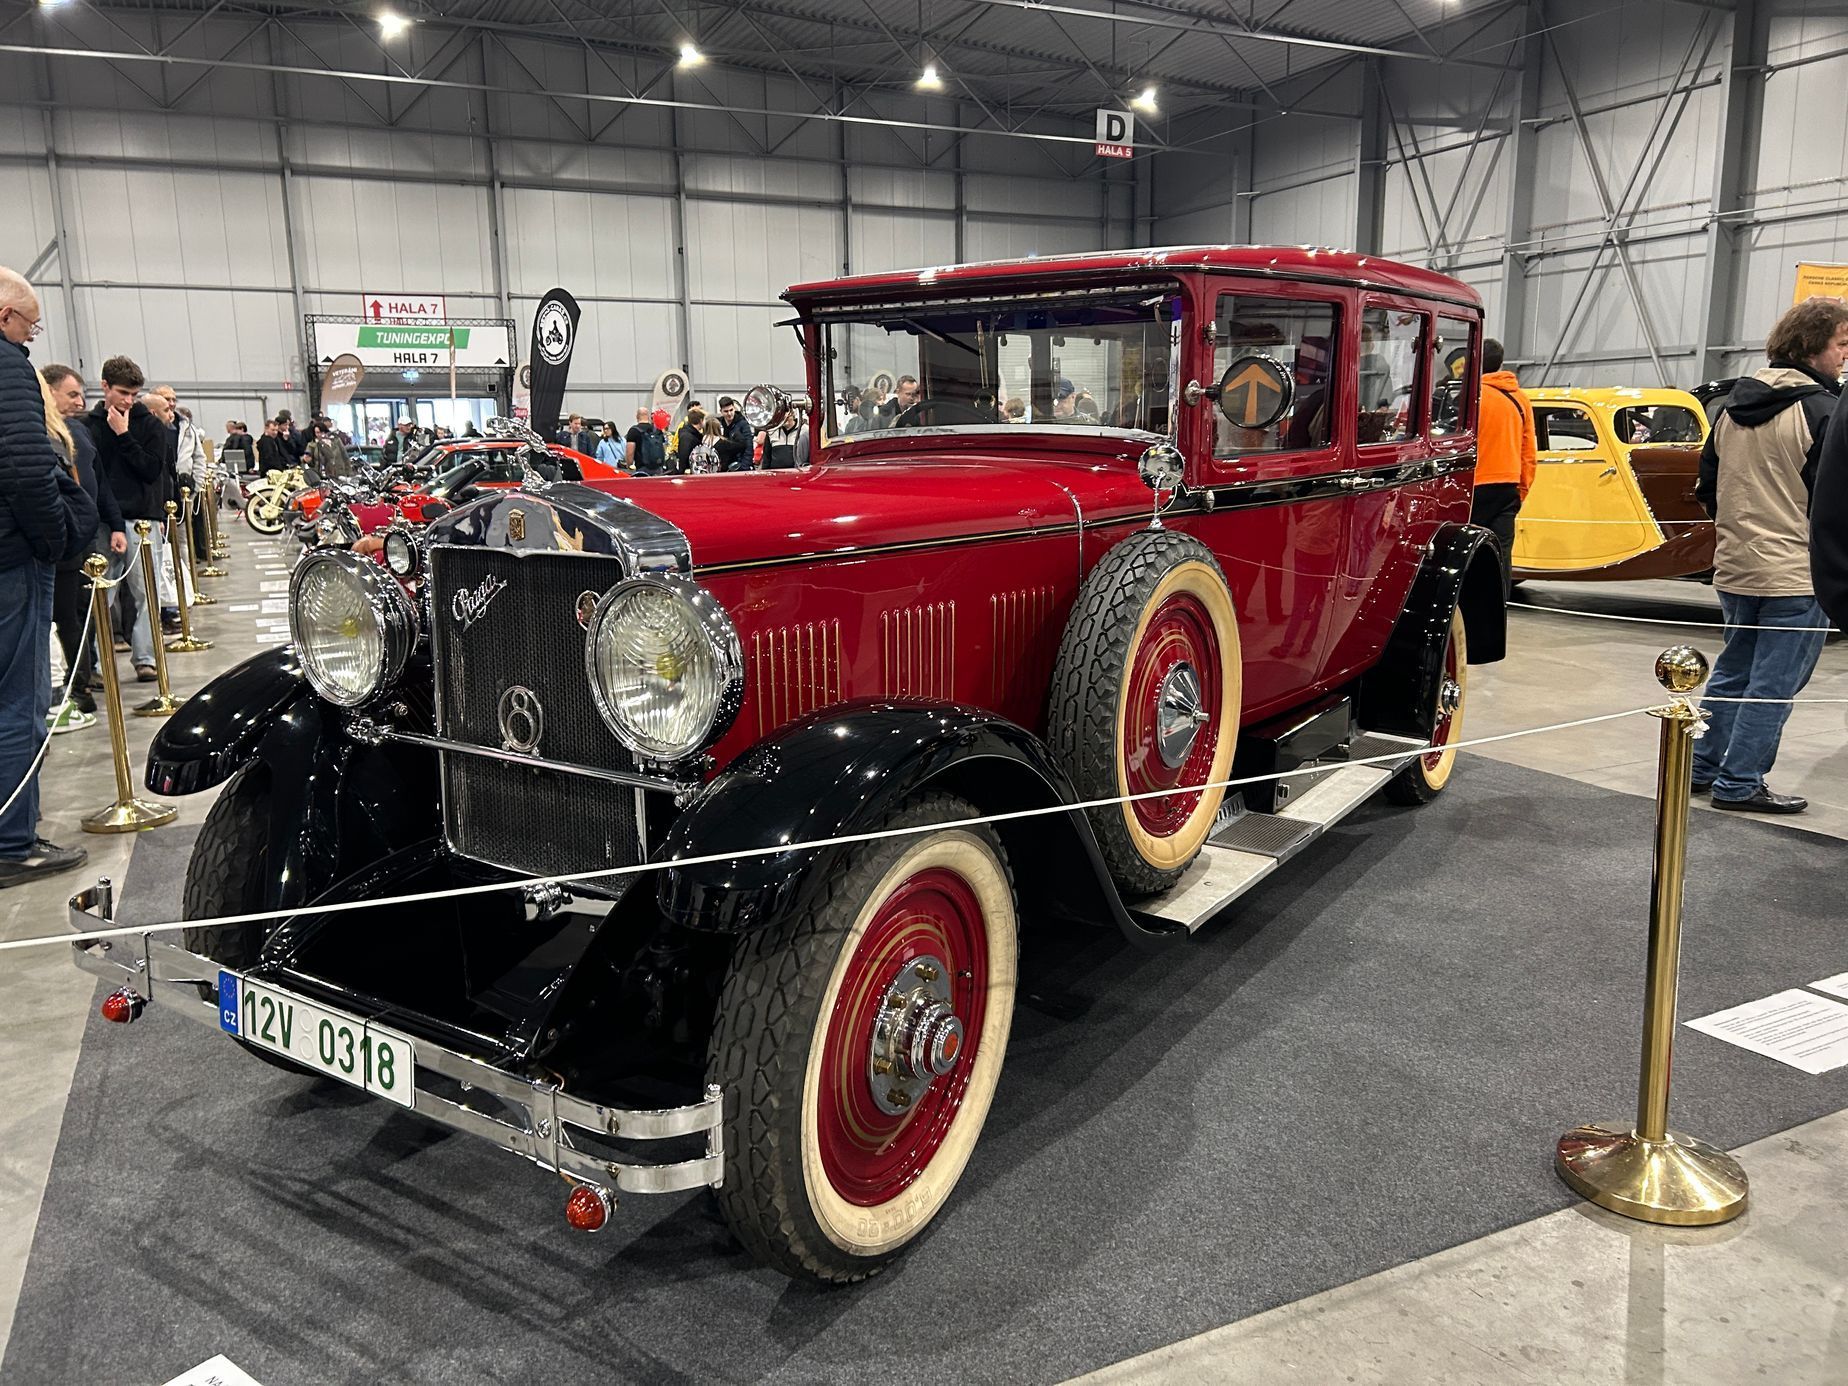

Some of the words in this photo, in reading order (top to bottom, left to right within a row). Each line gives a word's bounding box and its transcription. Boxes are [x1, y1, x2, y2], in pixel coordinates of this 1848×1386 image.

[1106, 114, 1126, 141] D
[1098, 145, 1123, 156] HALA
[1125, 148, 1132, 157] 5
[388, 302, 427, 314] HALA
[430, 303, 438, 314] 7
[393, 352, 427, 364] HALA
[430, 353, 438, 364] 7
[507, 689, 535, 750] 8
[223, 1009, 237, 1026] CZ
[244, 990, 294, 1050] 12V
[318, 1018, 395, 1090] 0318
